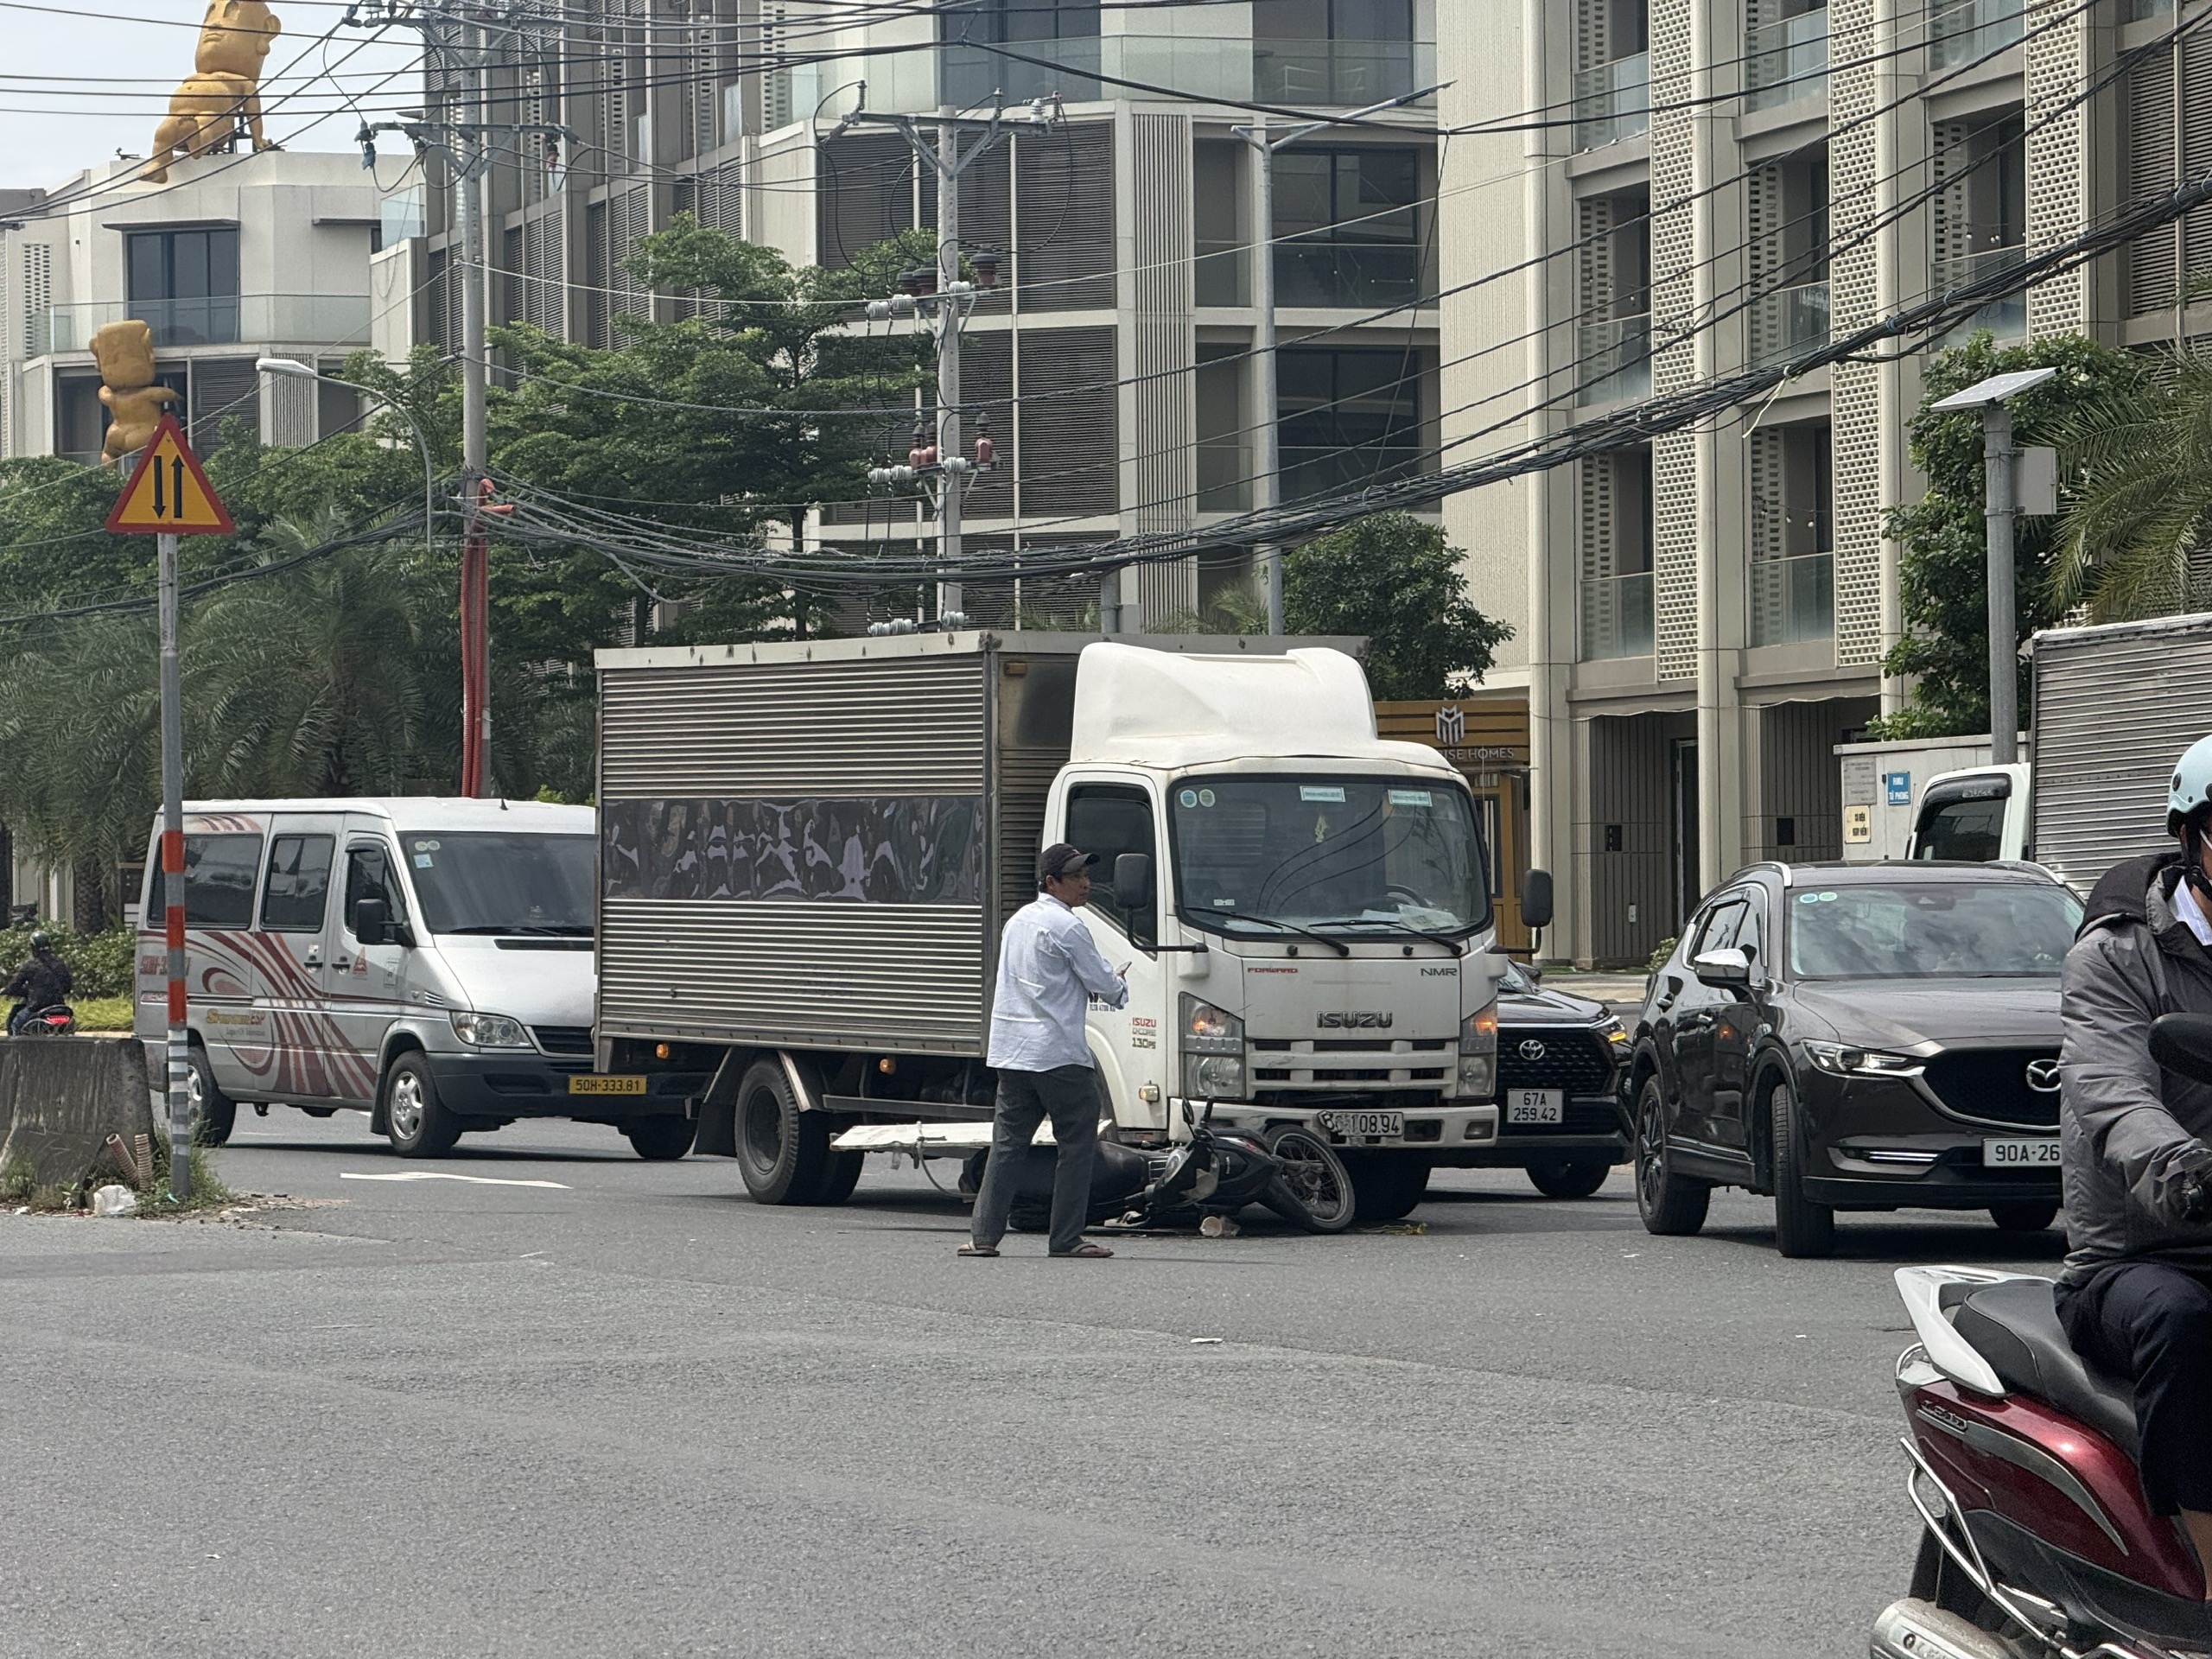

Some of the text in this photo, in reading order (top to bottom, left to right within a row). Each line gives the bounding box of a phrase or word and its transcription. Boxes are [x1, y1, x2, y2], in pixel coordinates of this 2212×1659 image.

[1468, 747, 1514, 760] HOMES
[1421, 968, 1458, 976] NMR
[1133, 1017, 1156, 1027] ISUZU
[1317, 1011, 1393, 1028] ISUZU
[575, 1079, 639, 1091] 50H-333.81
[1523, 1092, 1547, 1106] 67A
[1514, 1108, 1557, 1122] 259.42
